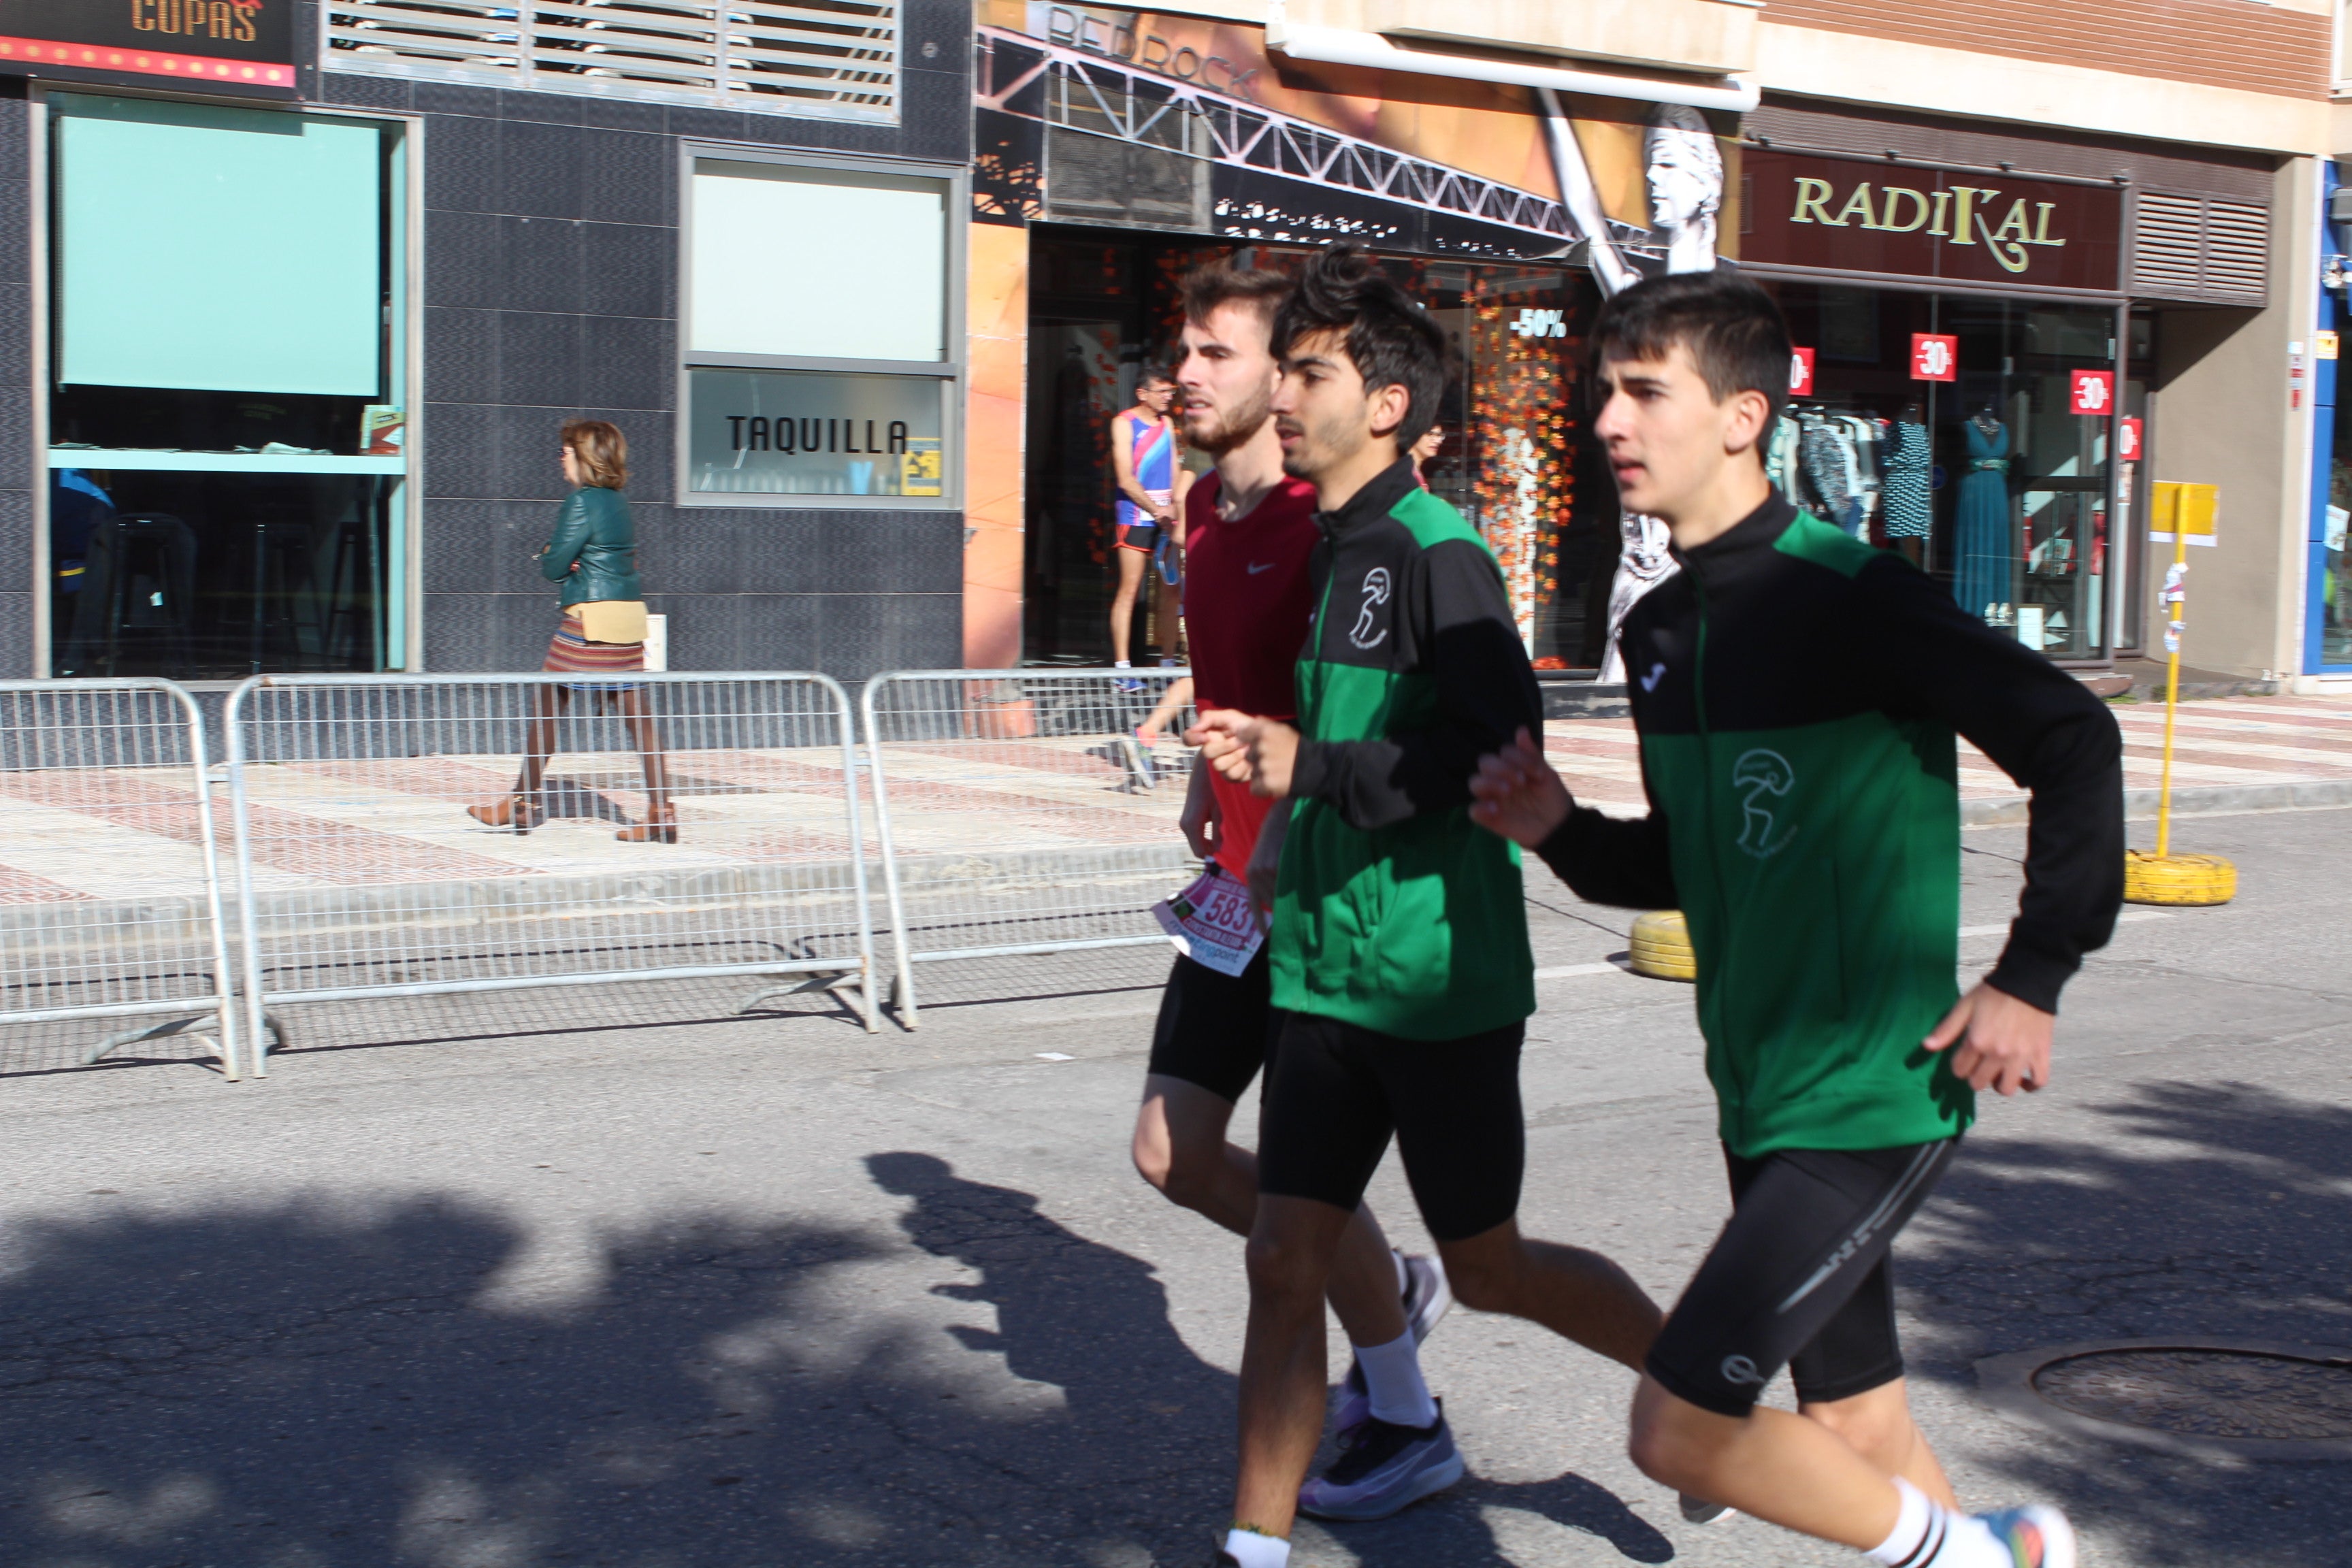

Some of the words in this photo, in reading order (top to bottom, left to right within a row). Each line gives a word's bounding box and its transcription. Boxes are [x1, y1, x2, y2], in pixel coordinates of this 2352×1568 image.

[131, 0, 257, 42] COPAS
[1789, 177, 2067, 273] RADIKAL
[1509, 308, 1567, 338] -50%
[725, 415, 908, 455] TAQUILLA
[1205, 892, 1252, 931] 583
